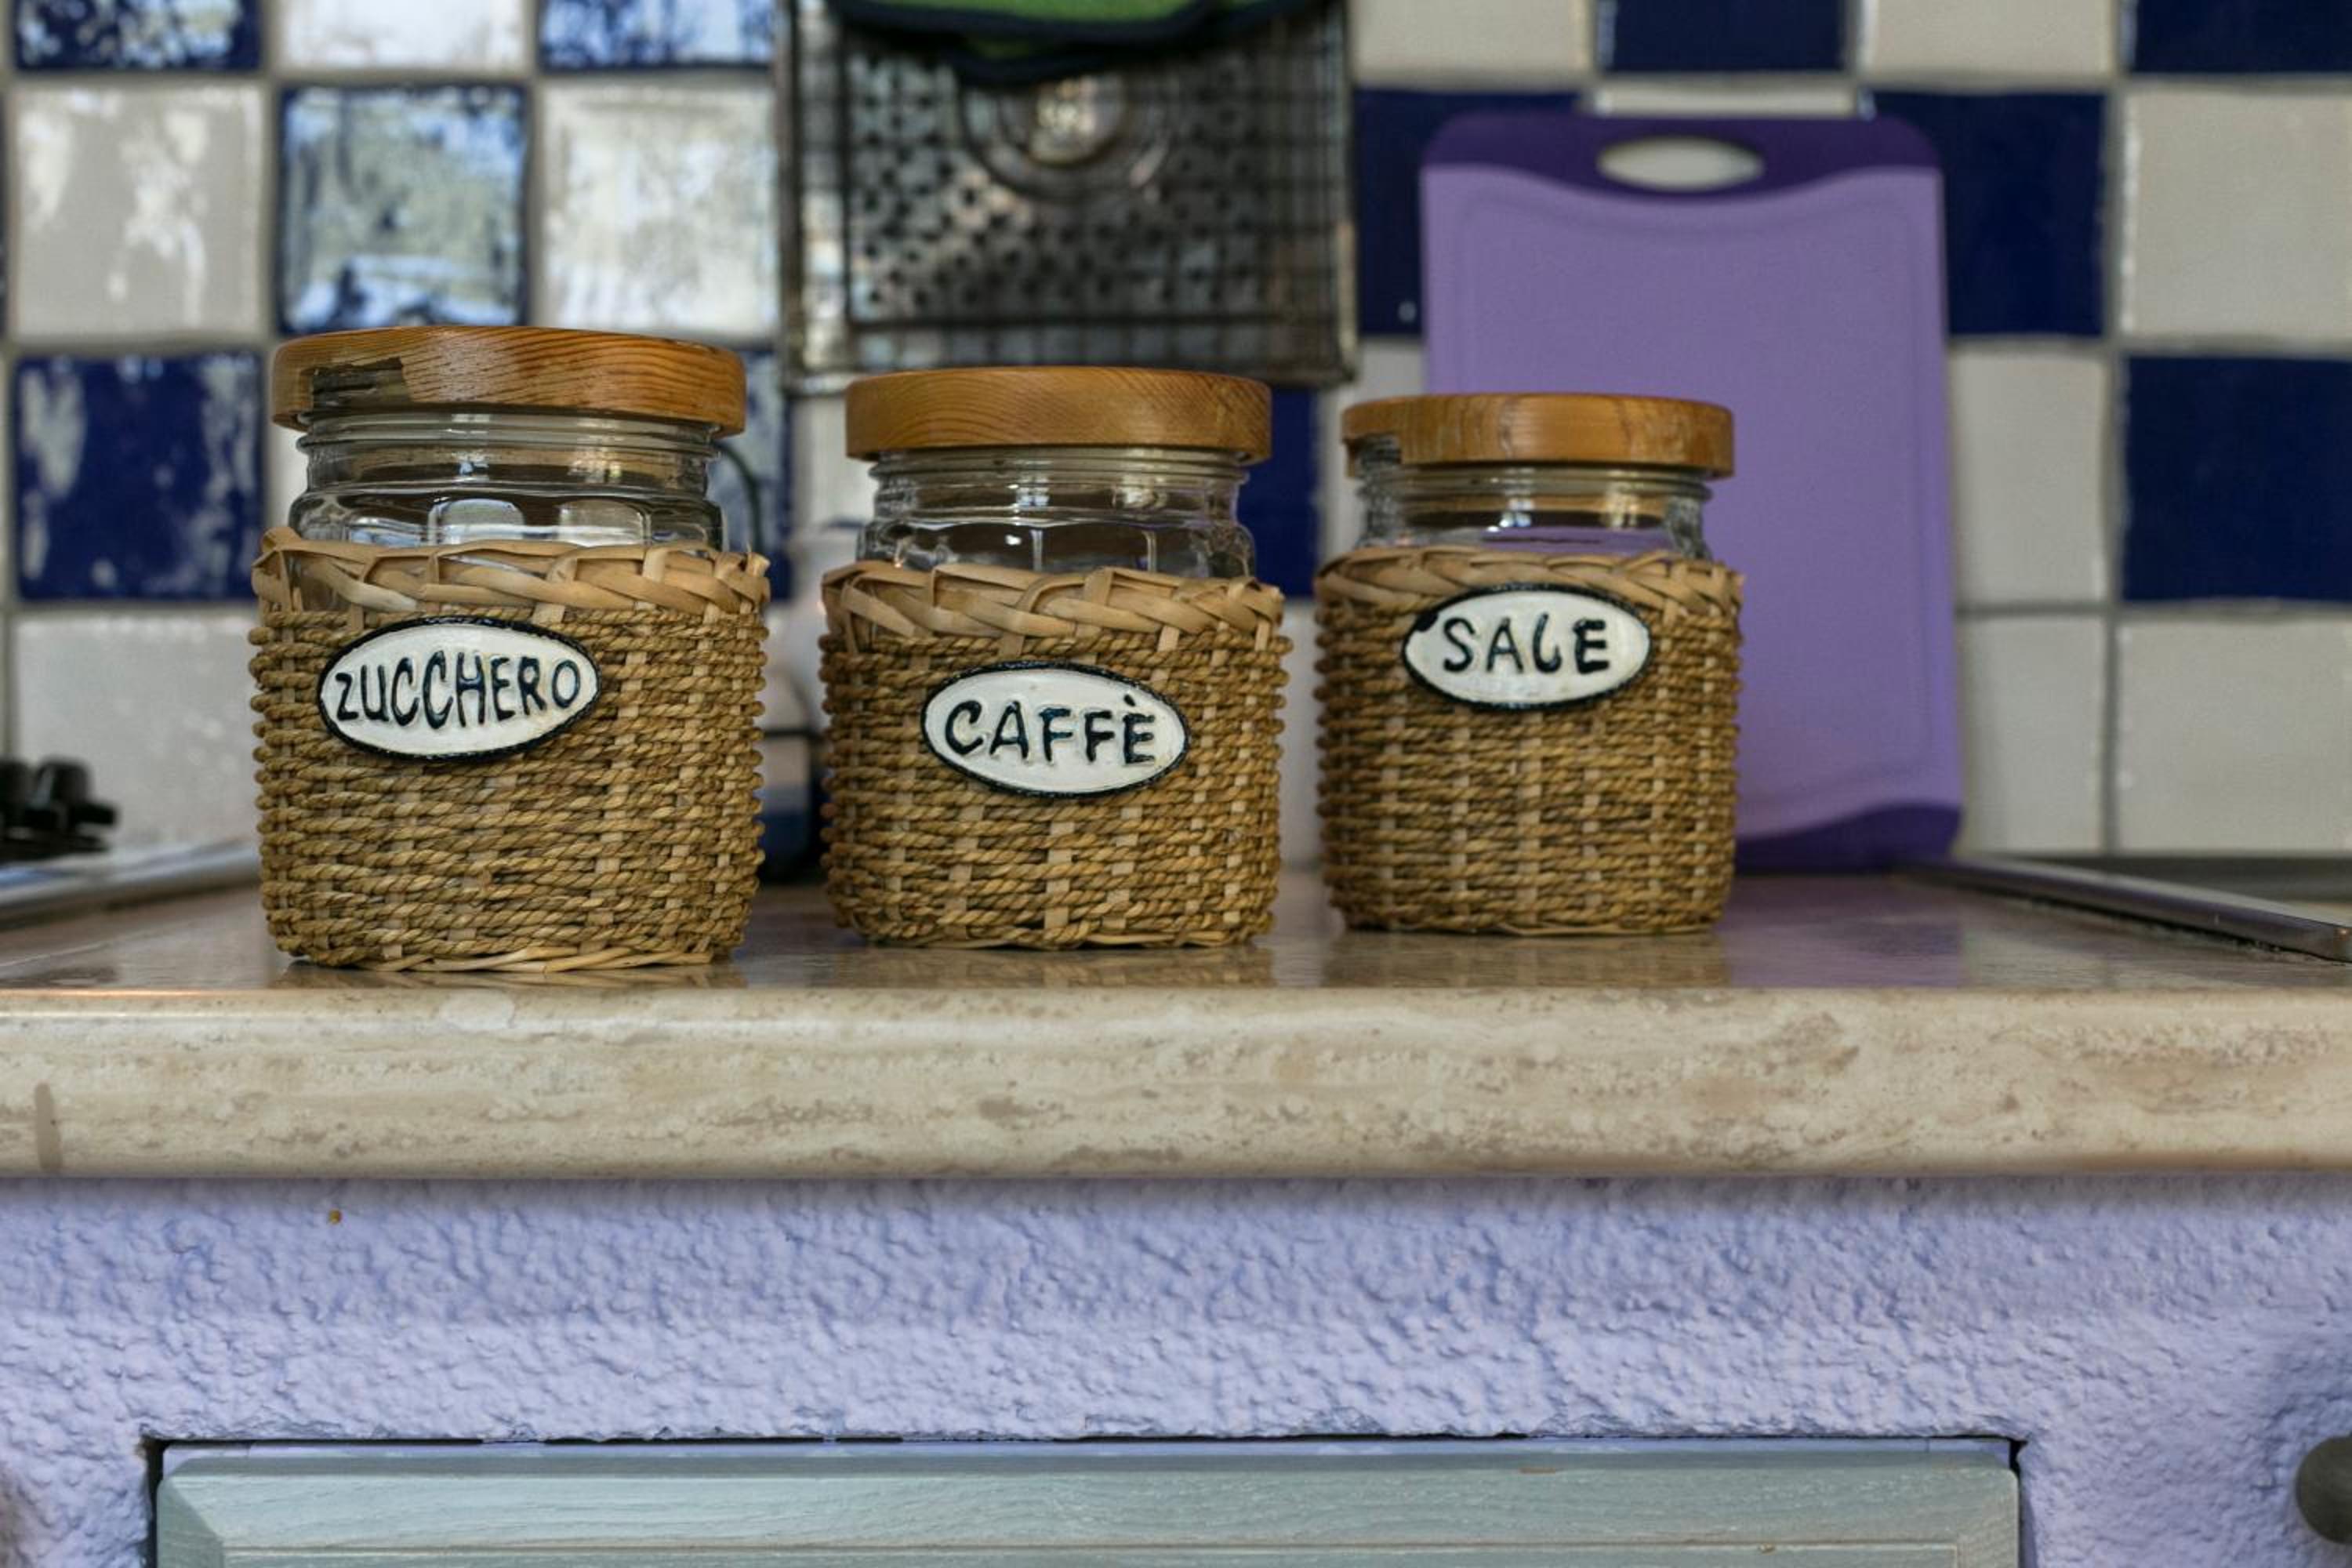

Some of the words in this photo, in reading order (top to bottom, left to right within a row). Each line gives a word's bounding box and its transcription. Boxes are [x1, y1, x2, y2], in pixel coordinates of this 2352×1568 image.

[1443, 612, 1610, 673] SALE
[336, 650, 580, 729] ZUCCHERO
[945, 695, 1156, 764] CAFFÈ
